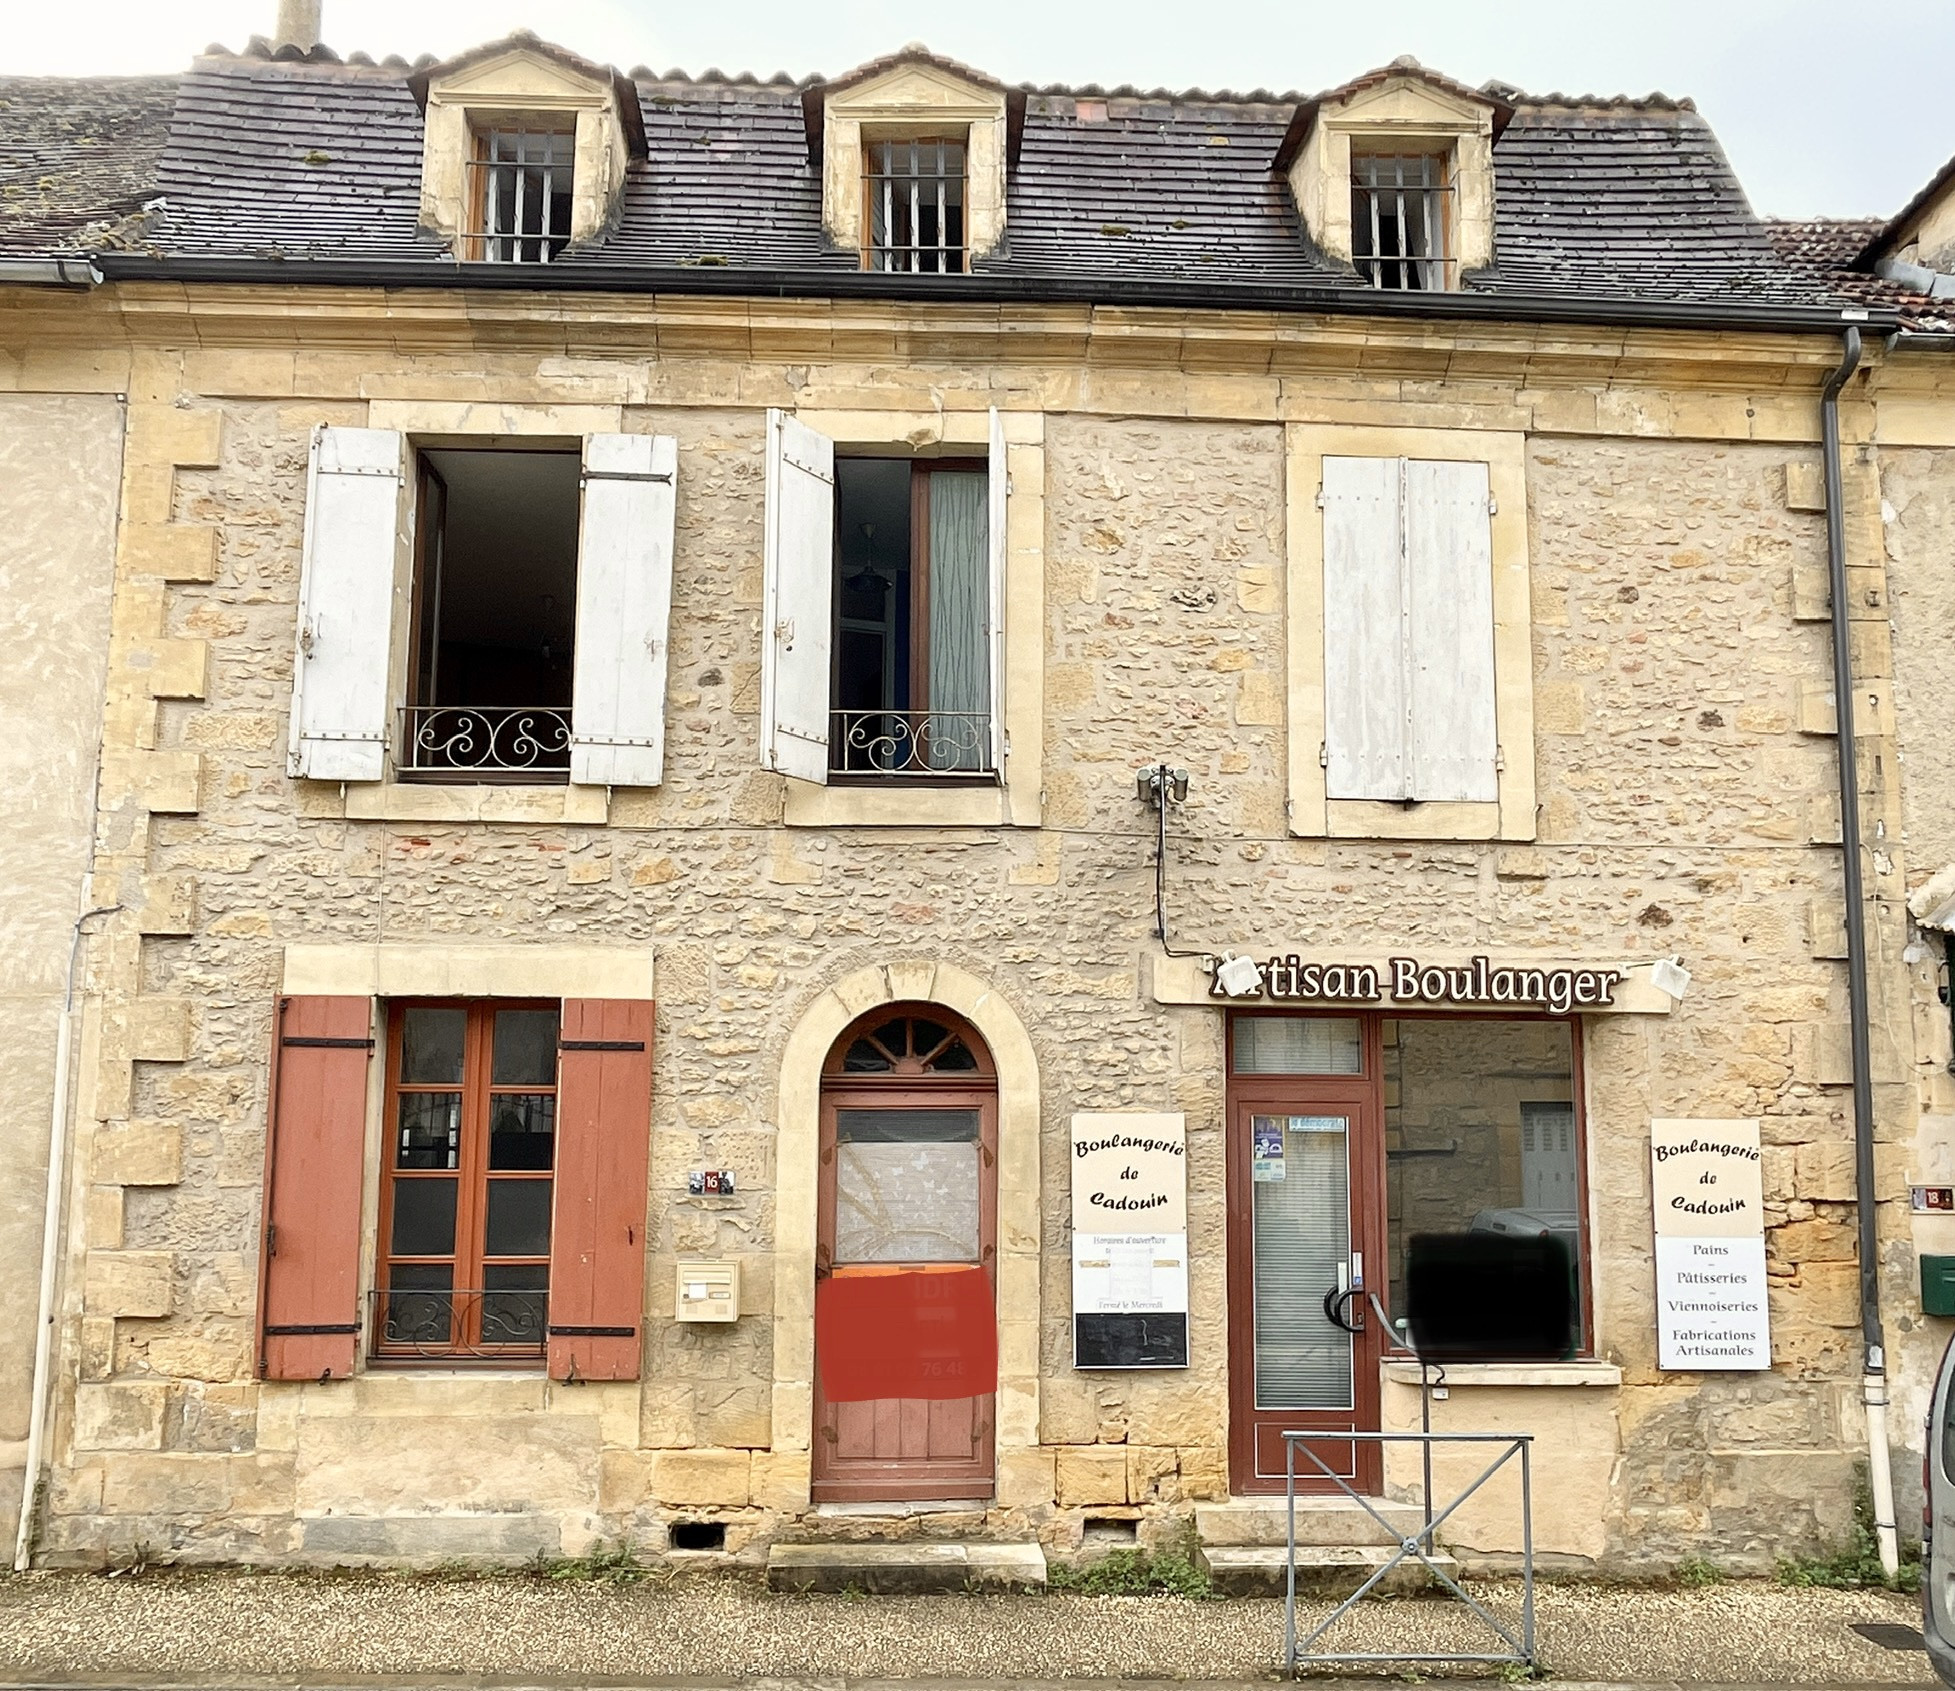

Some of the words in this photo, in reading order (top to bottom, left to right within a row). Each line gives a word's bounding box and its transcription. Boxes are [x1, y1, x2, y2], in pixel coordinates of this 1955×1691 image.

[1390, 956, 1619, 1014] Boulanger
[1075, 1134, 1184, 1158] Boulangerie
[1655, 1139, 1760, 1162] Boulangerie
[1120, 1166, 1139, 1180] de
[1699, 1171, 1717, 1185] de
[706, 1176, 718, 1188] 16
[1090, 1192, 1168, 1211] Cadouin
[1927, 1192, 1939, 1204] 18
[1671, 1196, 1746, 1215] Cadouin
[1693, 1245, 1729, 1255] Pains
[1677, 1272, 1748, 1284] Pâtisseries
[1668, 1300, 1759, 1312] Viennoiseries
[1672, 1329, 1756, 1341] Fabrications
[1675, 1345, 1754, 1356] Artisanales
